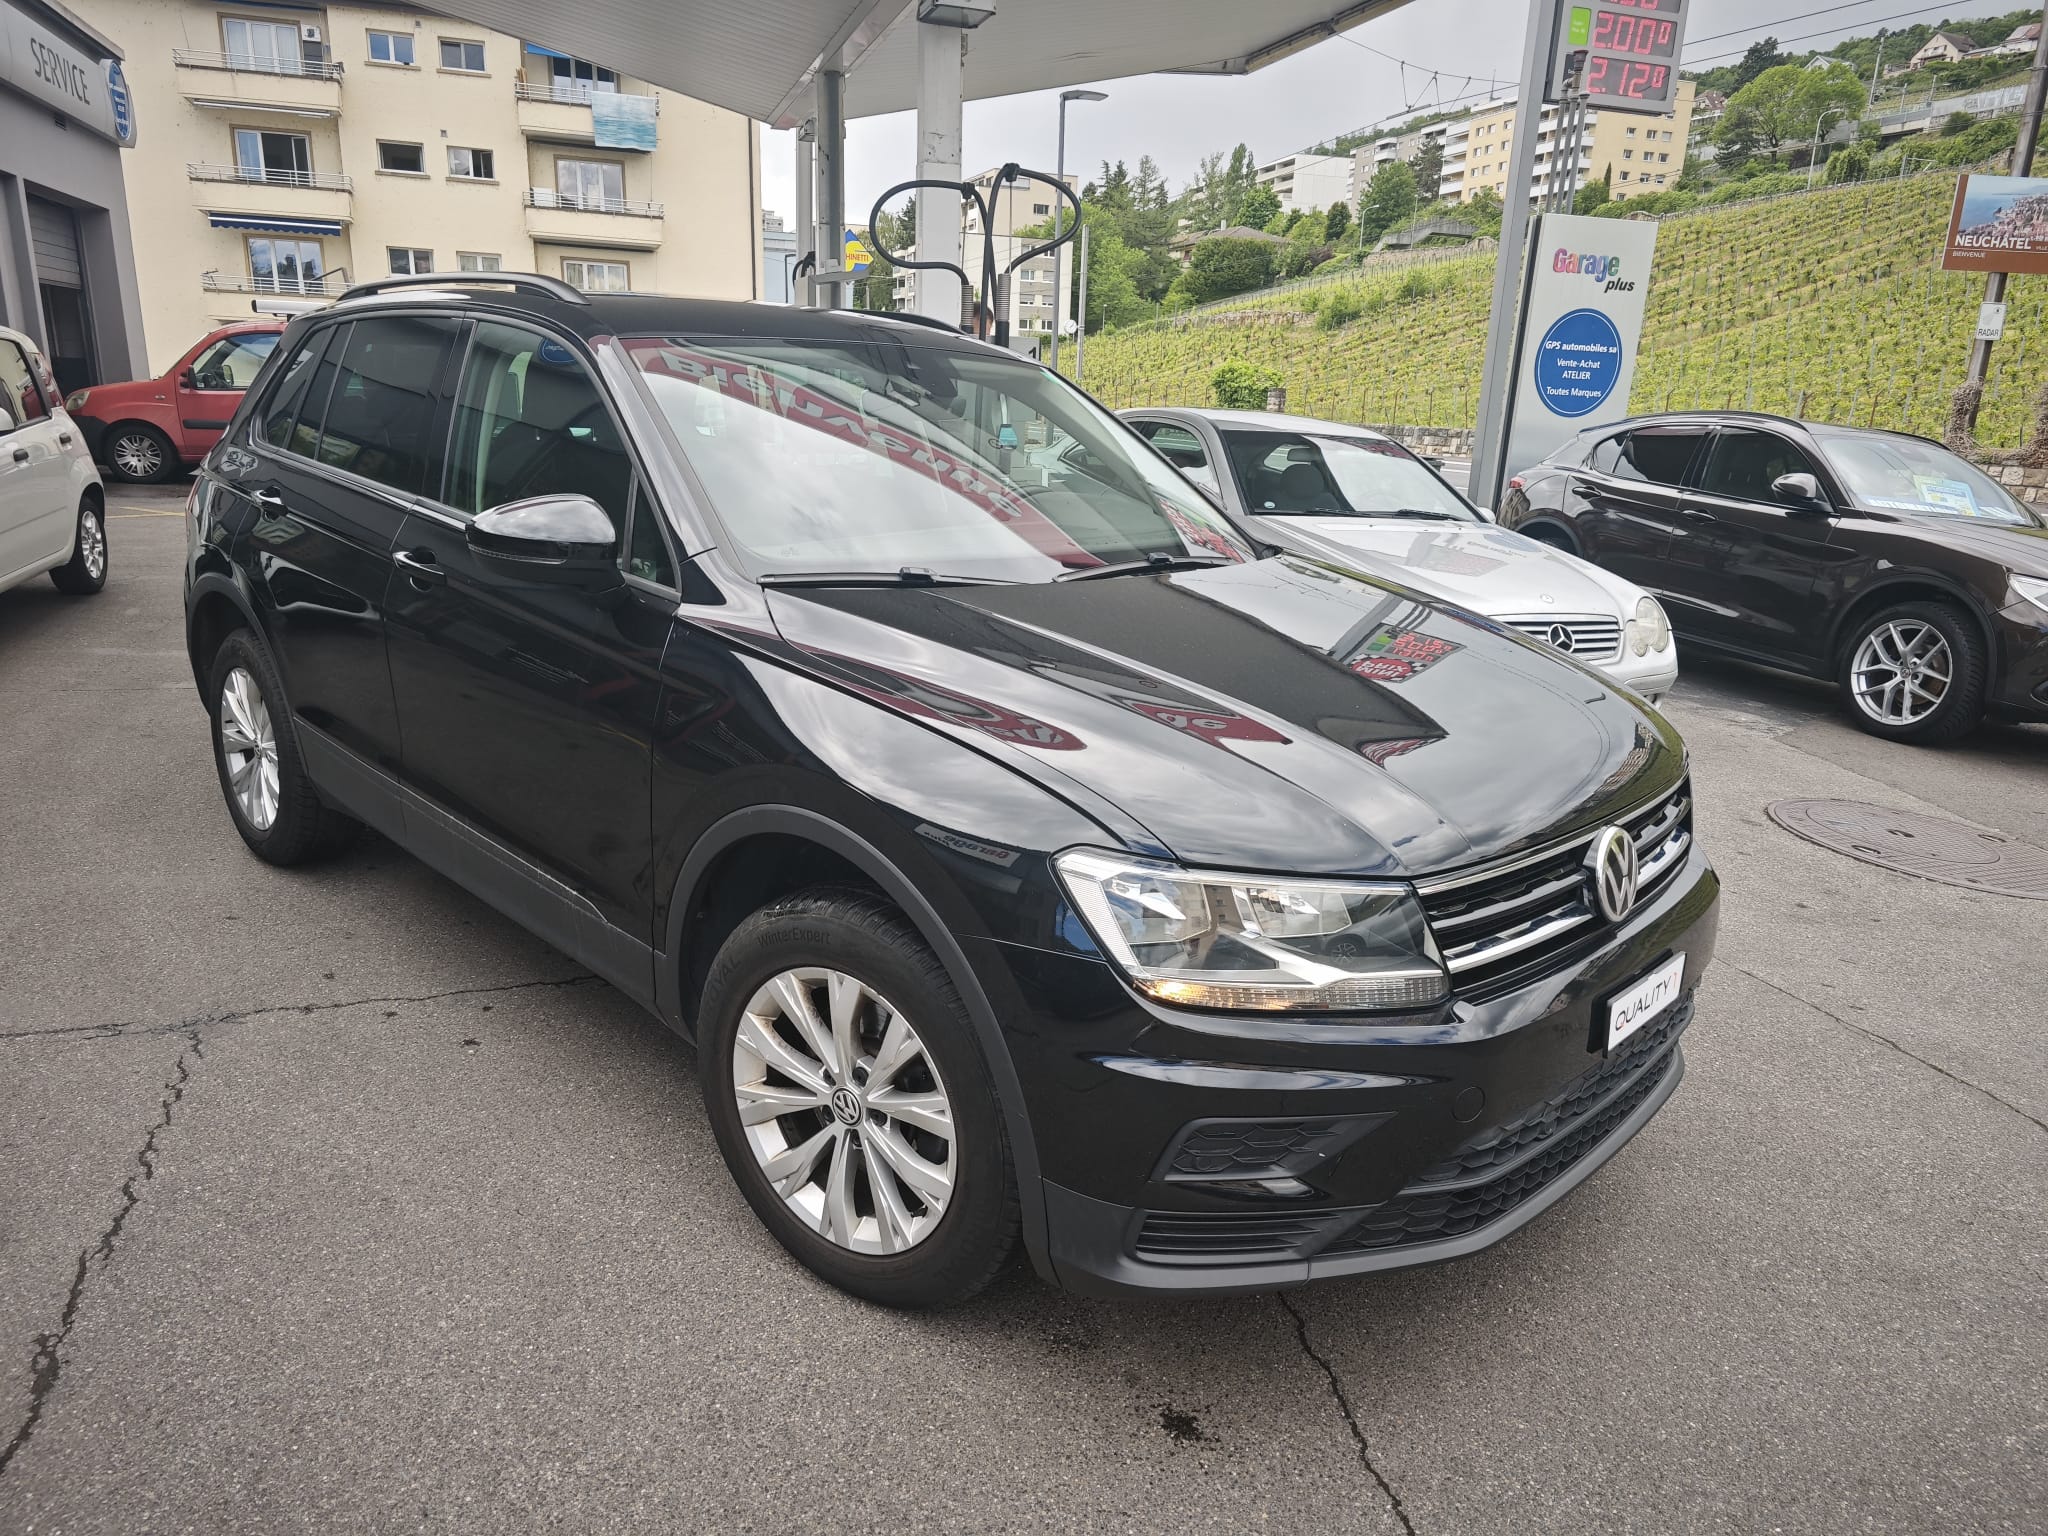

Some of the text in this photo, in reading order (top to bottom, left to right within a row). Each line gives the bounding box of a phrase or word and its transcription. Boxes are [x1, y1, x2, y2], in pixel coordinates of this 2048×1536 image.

[30, 37, 91, 106] SERVICE
[845, 253, 869, 262] HINETTI
[1952, 250, 1986, 258] BIENVENUE
[1553, 248, 1620, 283] Garage
[1604, 277, 1636, 294] plus
[1977, 328, 1999, 337] RADAR
[1028, 346, 1036, 359] 1
[1545, 340, 1561, 350] GPS
[1562, 342, 1607, 353] automobiles
[1557, 358, 1601, 369] Vente-Achat
[1562, 370, 1591, 380] ATELIER
[1546, 386, 1602, 399] Toutes Marques
[1614, 975, 1672, 1031] QUALITY
